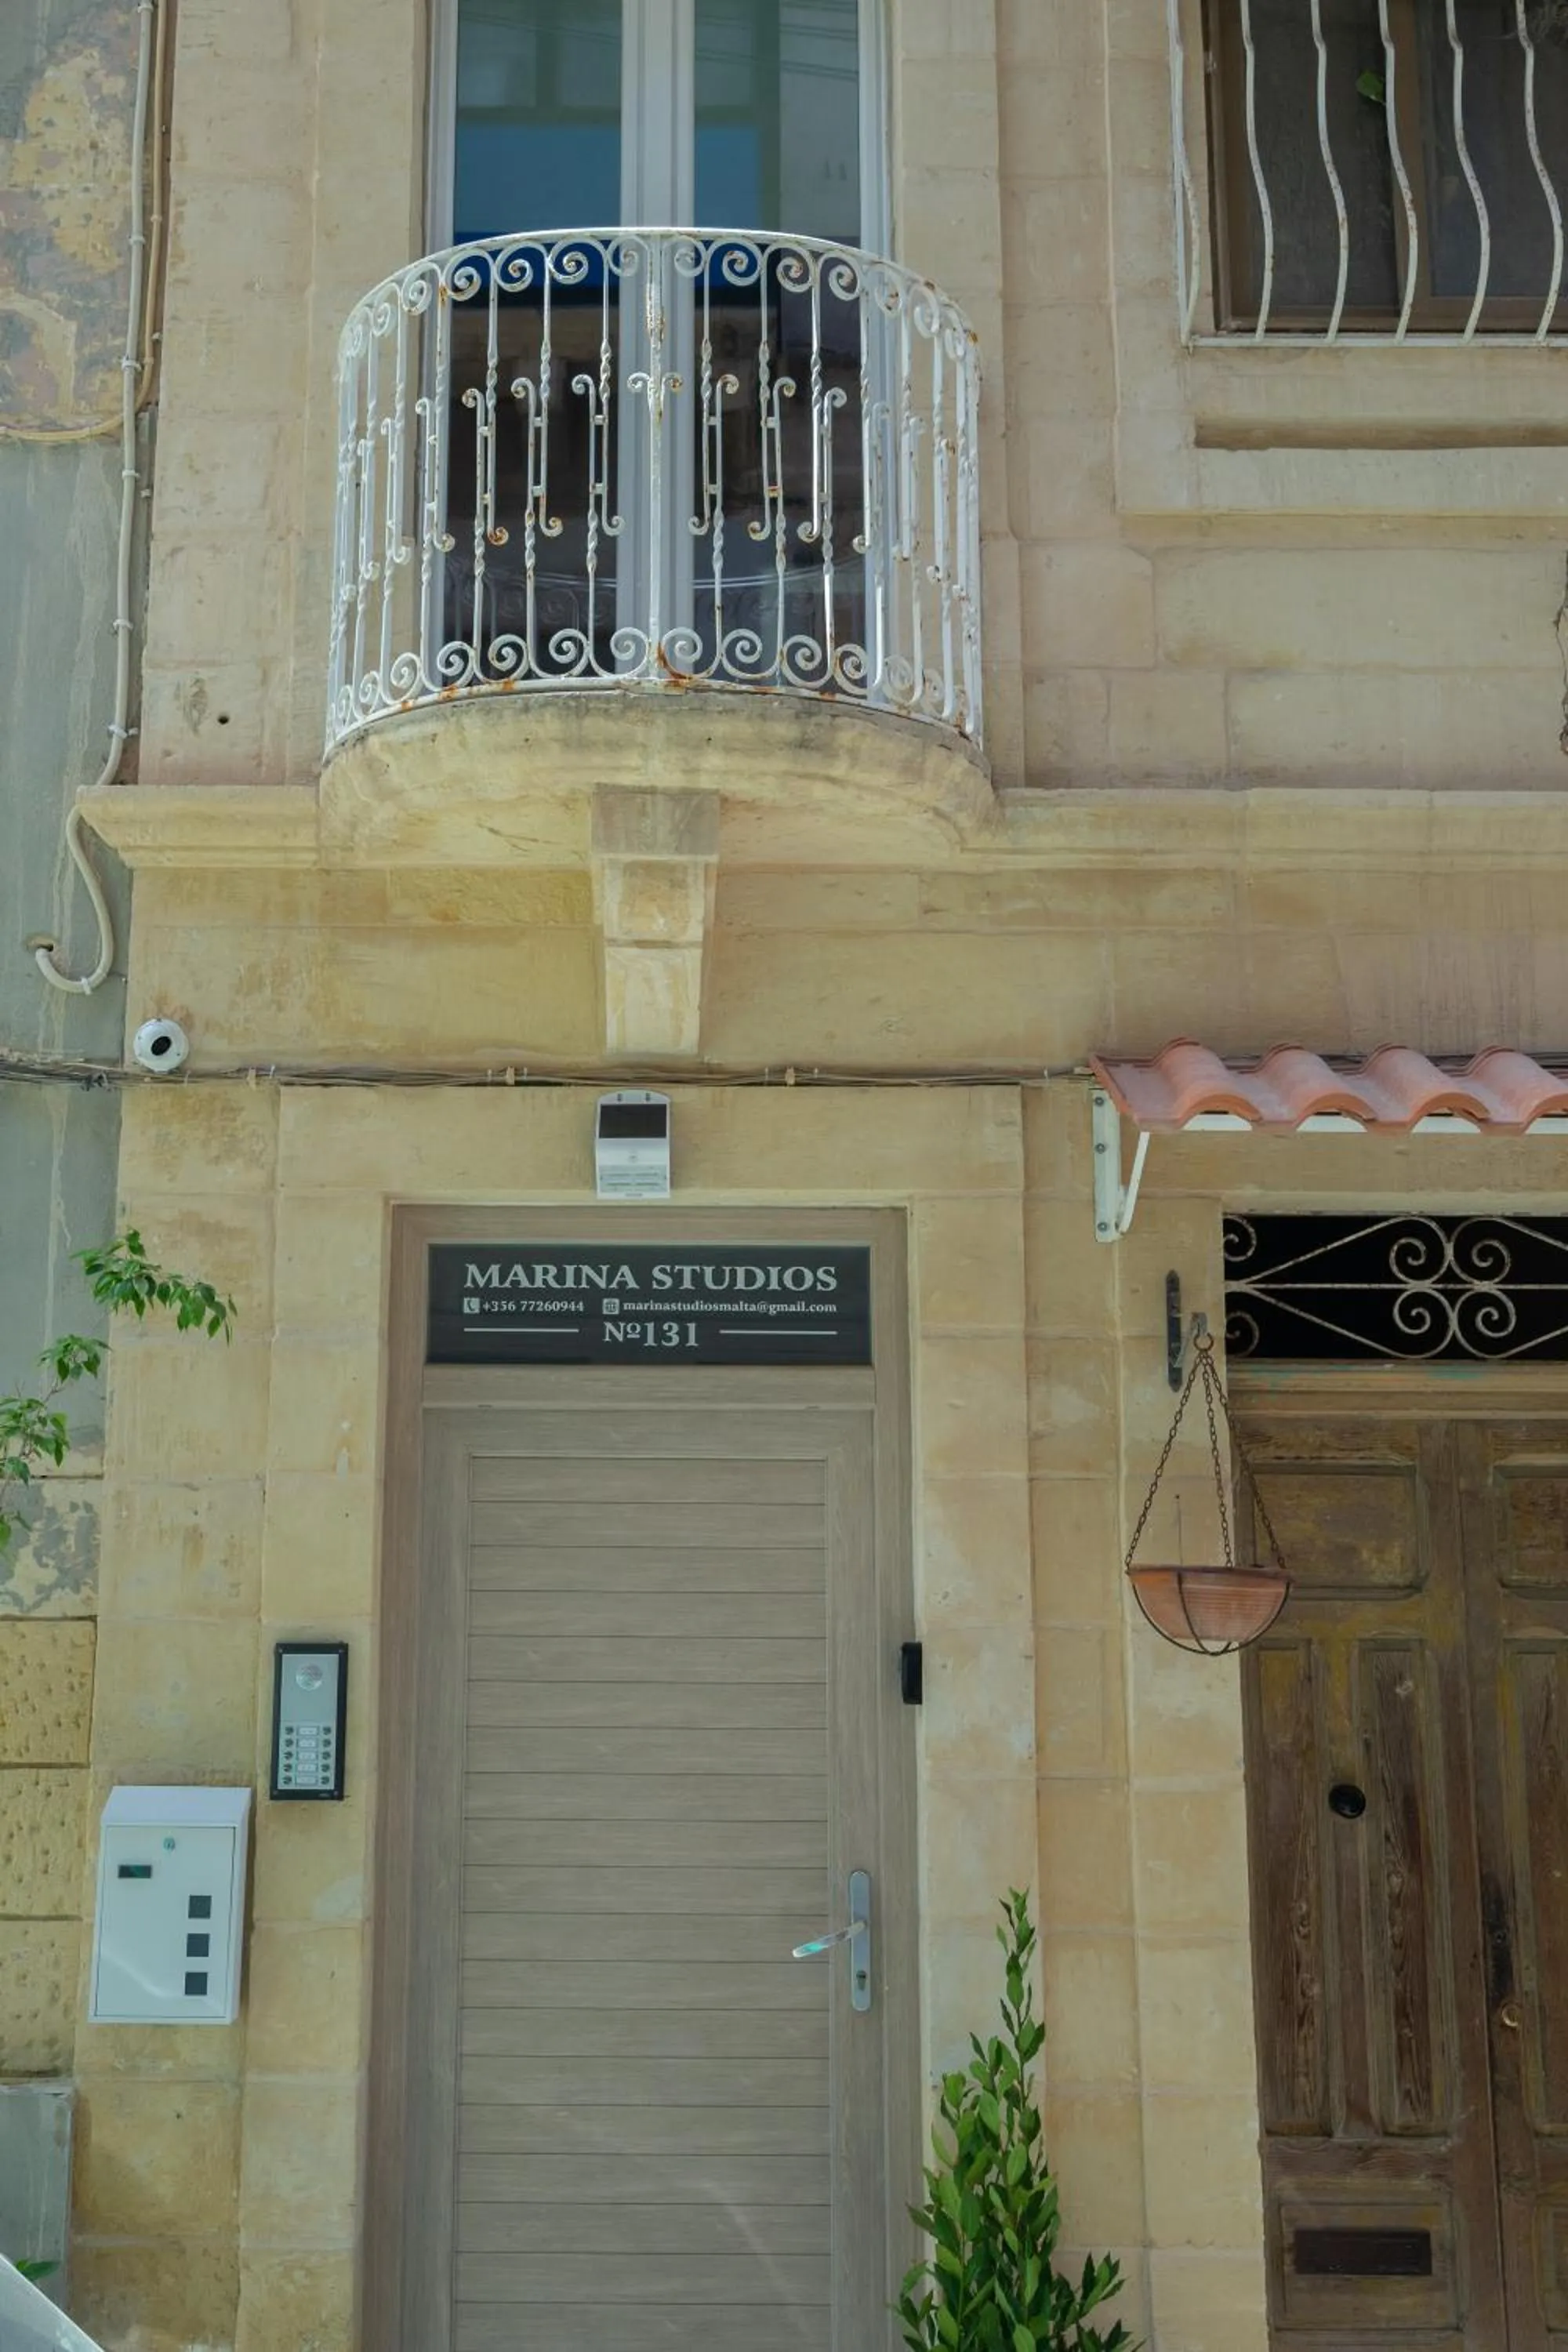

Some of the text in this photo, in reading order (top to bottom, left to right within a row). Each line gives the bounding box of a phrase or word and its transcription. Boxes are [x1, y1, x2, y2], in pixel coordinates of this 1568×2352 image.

[464, 1263, 838, 1291] MARINA STUDIOS
[482, 1300, 585, 1312] +356 77260944
[622, 1299, 837, 1316] marinastudiosmalta@gmail.com
